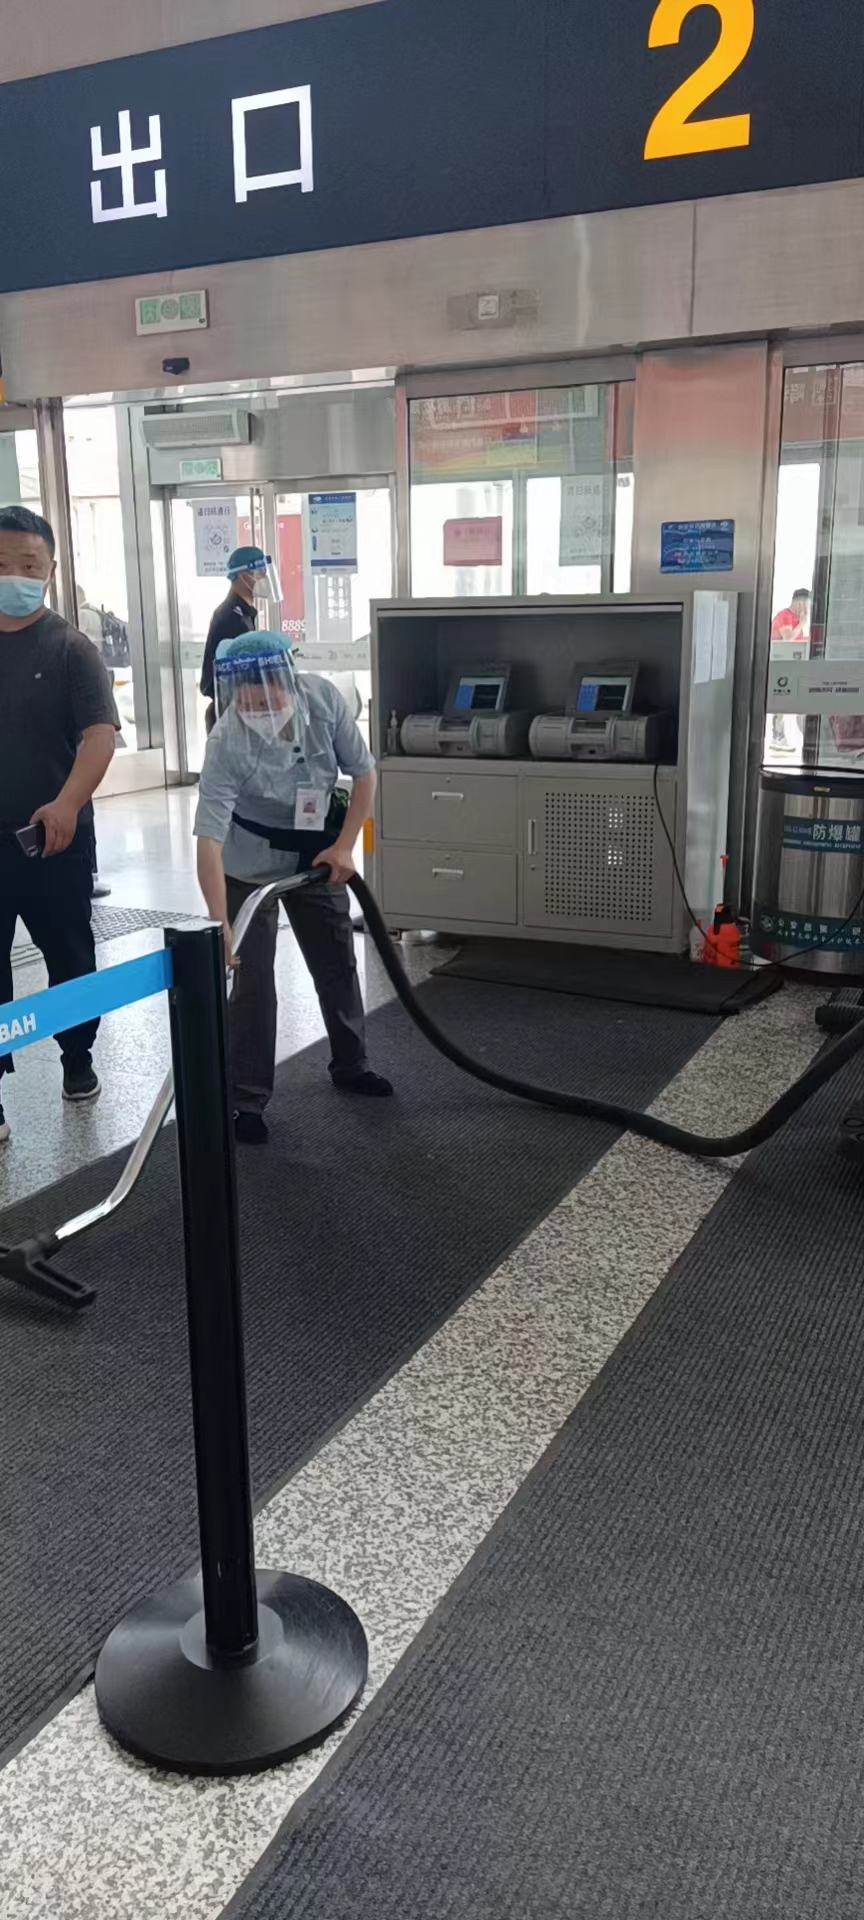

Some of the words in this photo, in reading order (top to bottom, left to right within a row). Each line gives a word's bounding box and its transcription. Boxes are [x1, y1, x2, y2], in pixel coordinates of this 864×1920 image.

[644, 0, 754, 160] 2
[90, 84, 314, 223] 出口
[258, 654, 287, 667] SHIEL
[812, 823, 861, 842] 防爆罐
